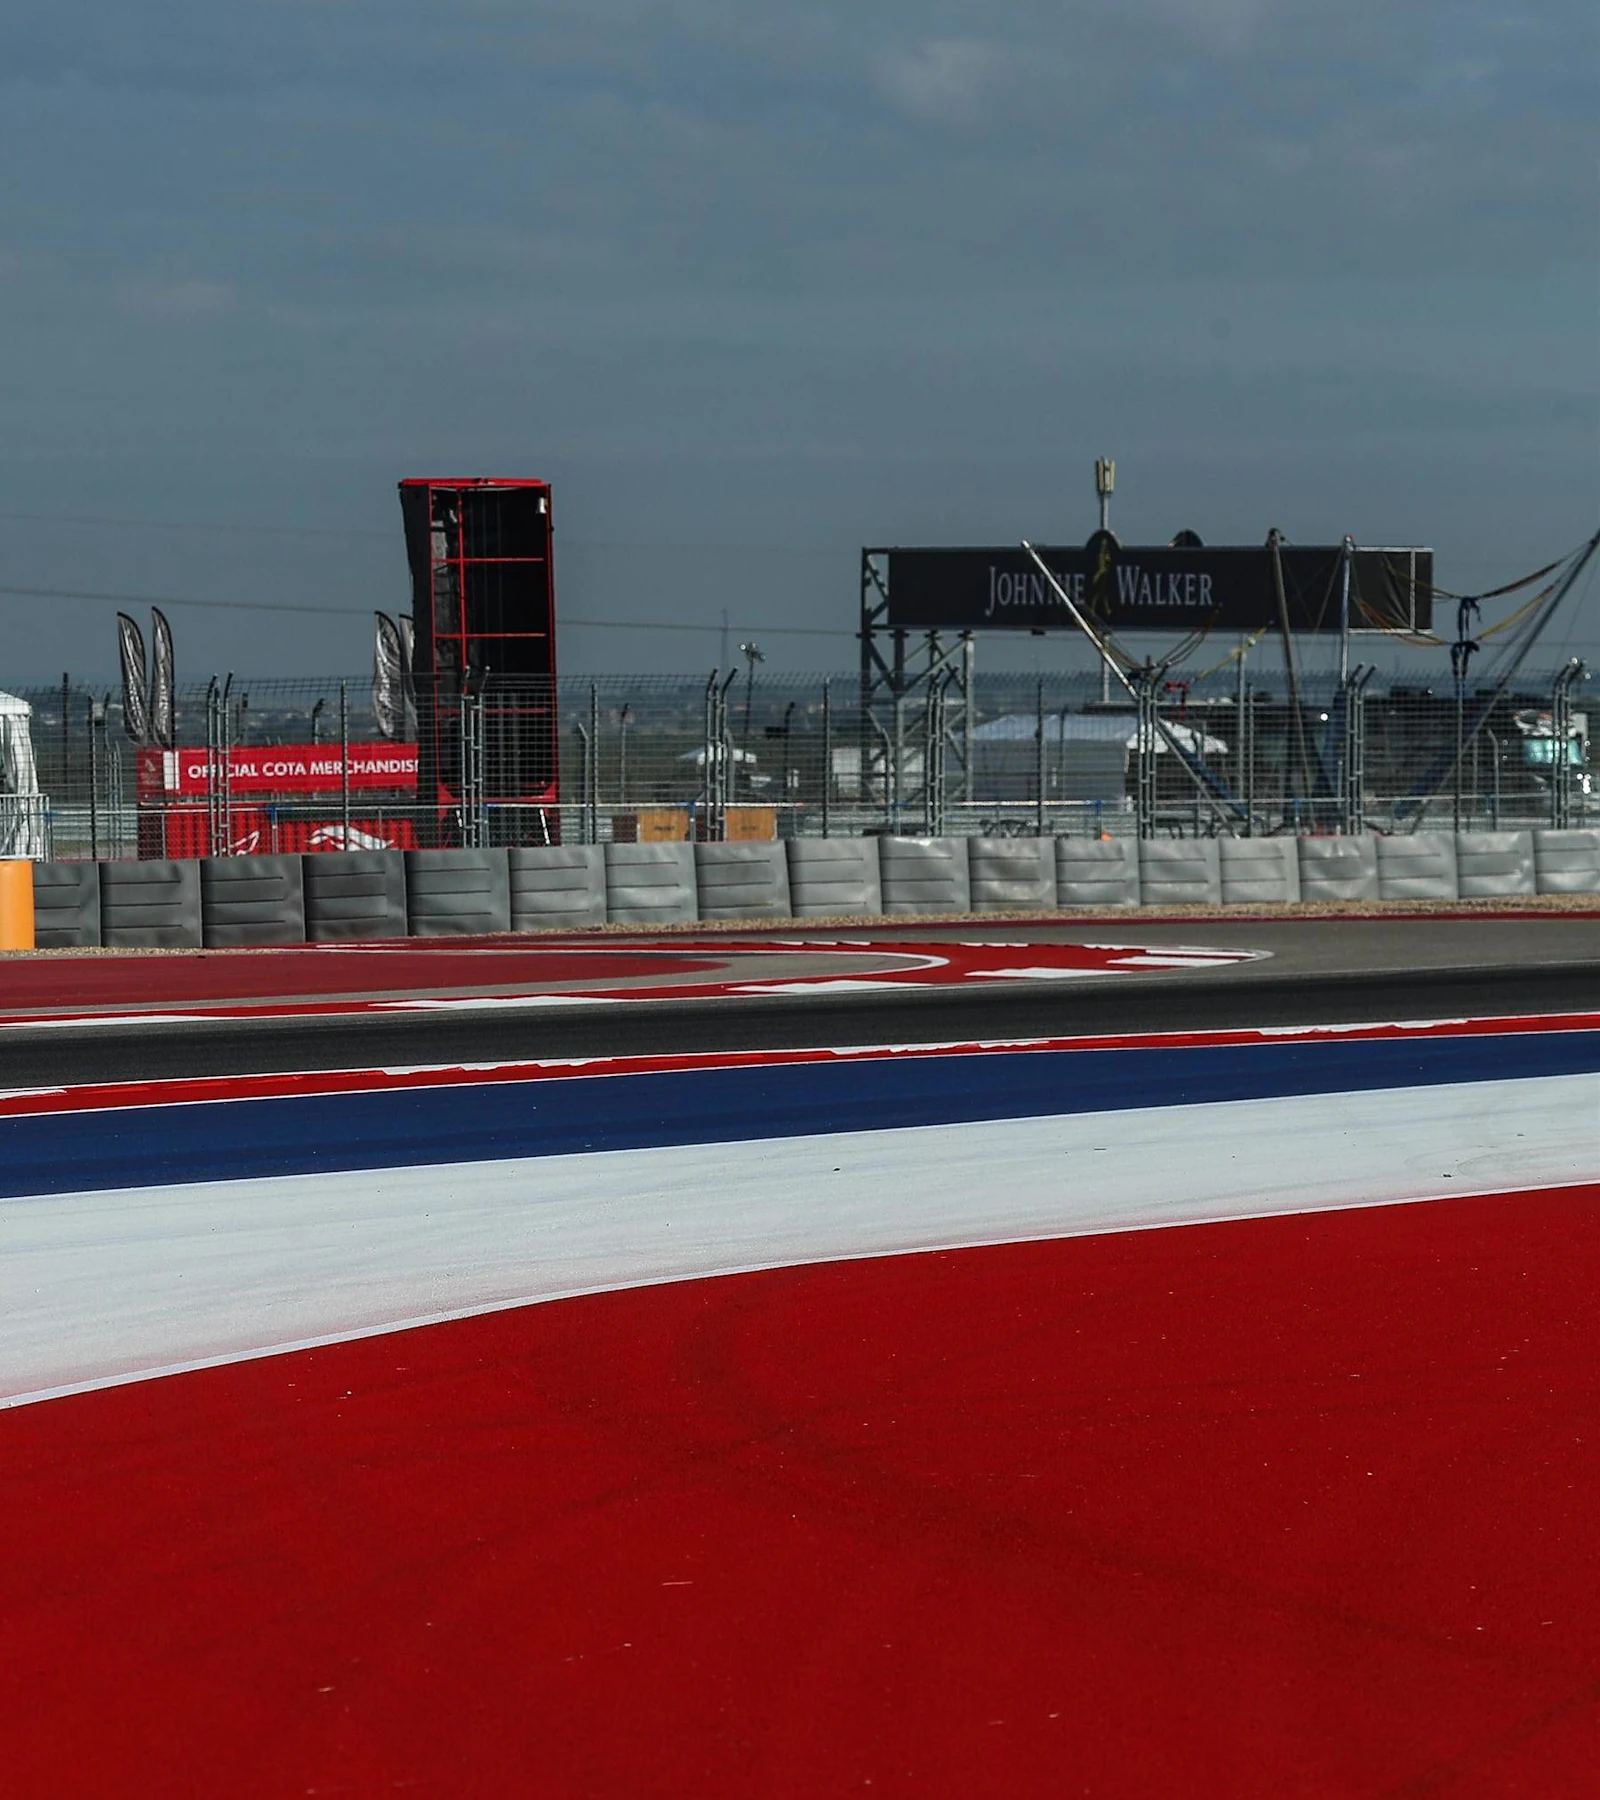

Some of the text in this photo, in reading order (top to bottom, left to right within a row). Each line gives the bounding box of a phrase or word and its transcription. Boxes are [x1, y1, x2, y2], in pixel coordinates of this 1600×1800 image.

[1116, 565, 1214, 606] WALKER
[187, 763, 259, 779] OFFICIAL
[262, 761, 307, 777] COTA
